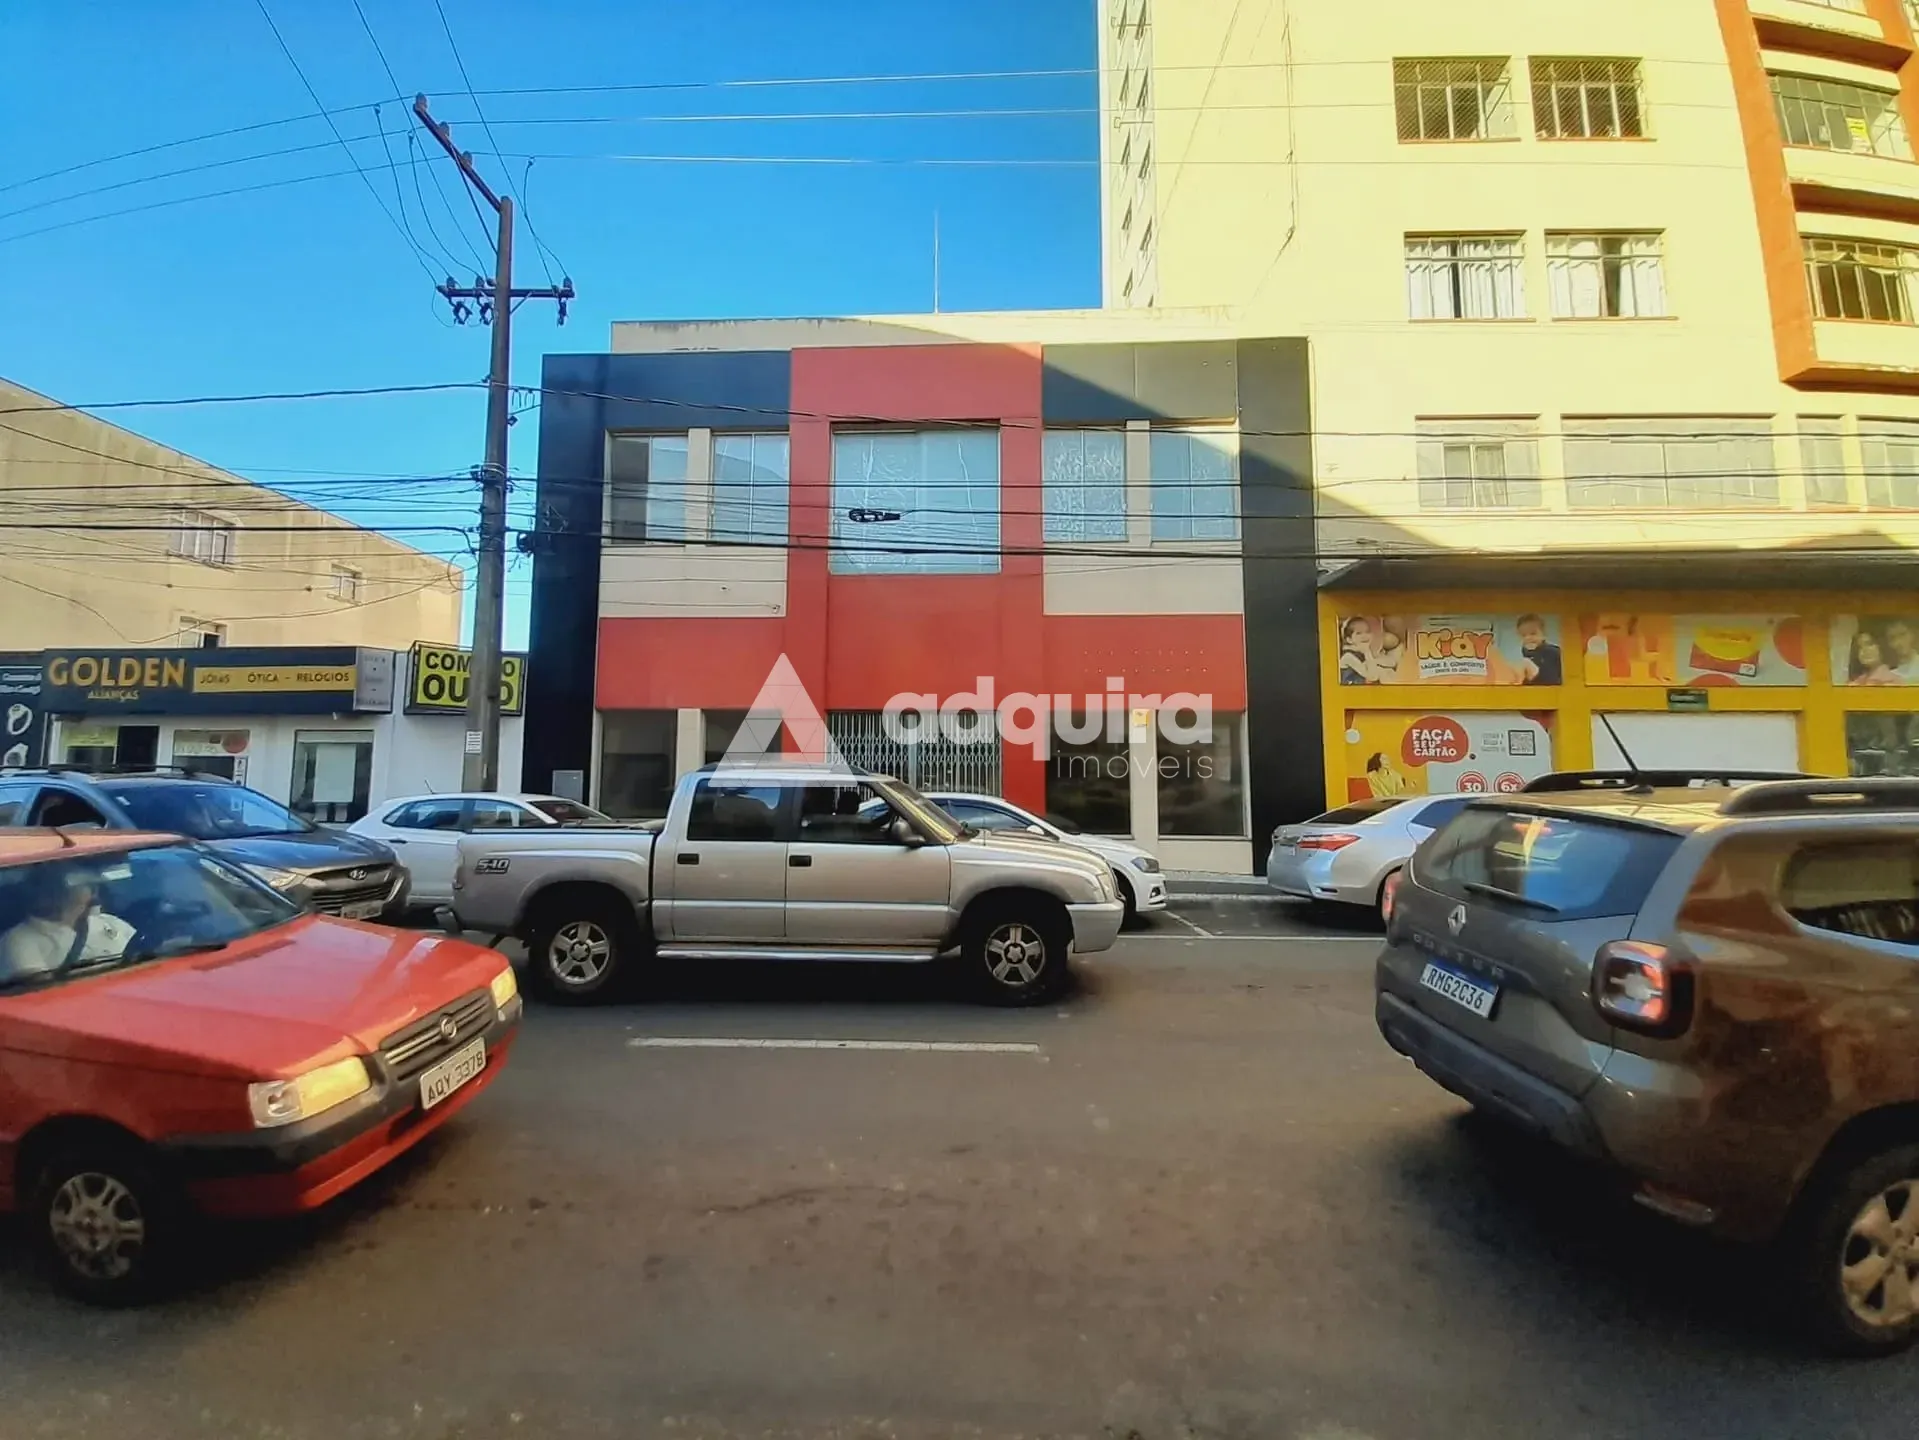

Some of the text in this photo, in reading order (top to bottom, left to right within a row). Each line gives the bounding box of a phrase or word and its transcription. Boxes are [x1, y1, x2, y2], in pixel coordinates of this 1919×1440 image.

[49, 656, 186, 688] GOLDEN
[425, 651, 515, 677] COMO
[423, 674, 514, 706] OUO
[1412, 729, 1455, 743] FAÇA
[1413, 740, 1437, 748] SEU
[1414, 746, 1457, 757] CARTÃO
[1463, 782, 1482, 793] 30
[1426, 967, 1484, 1010] RMG2C36
[428, 1073, 453, 1104] AQY
